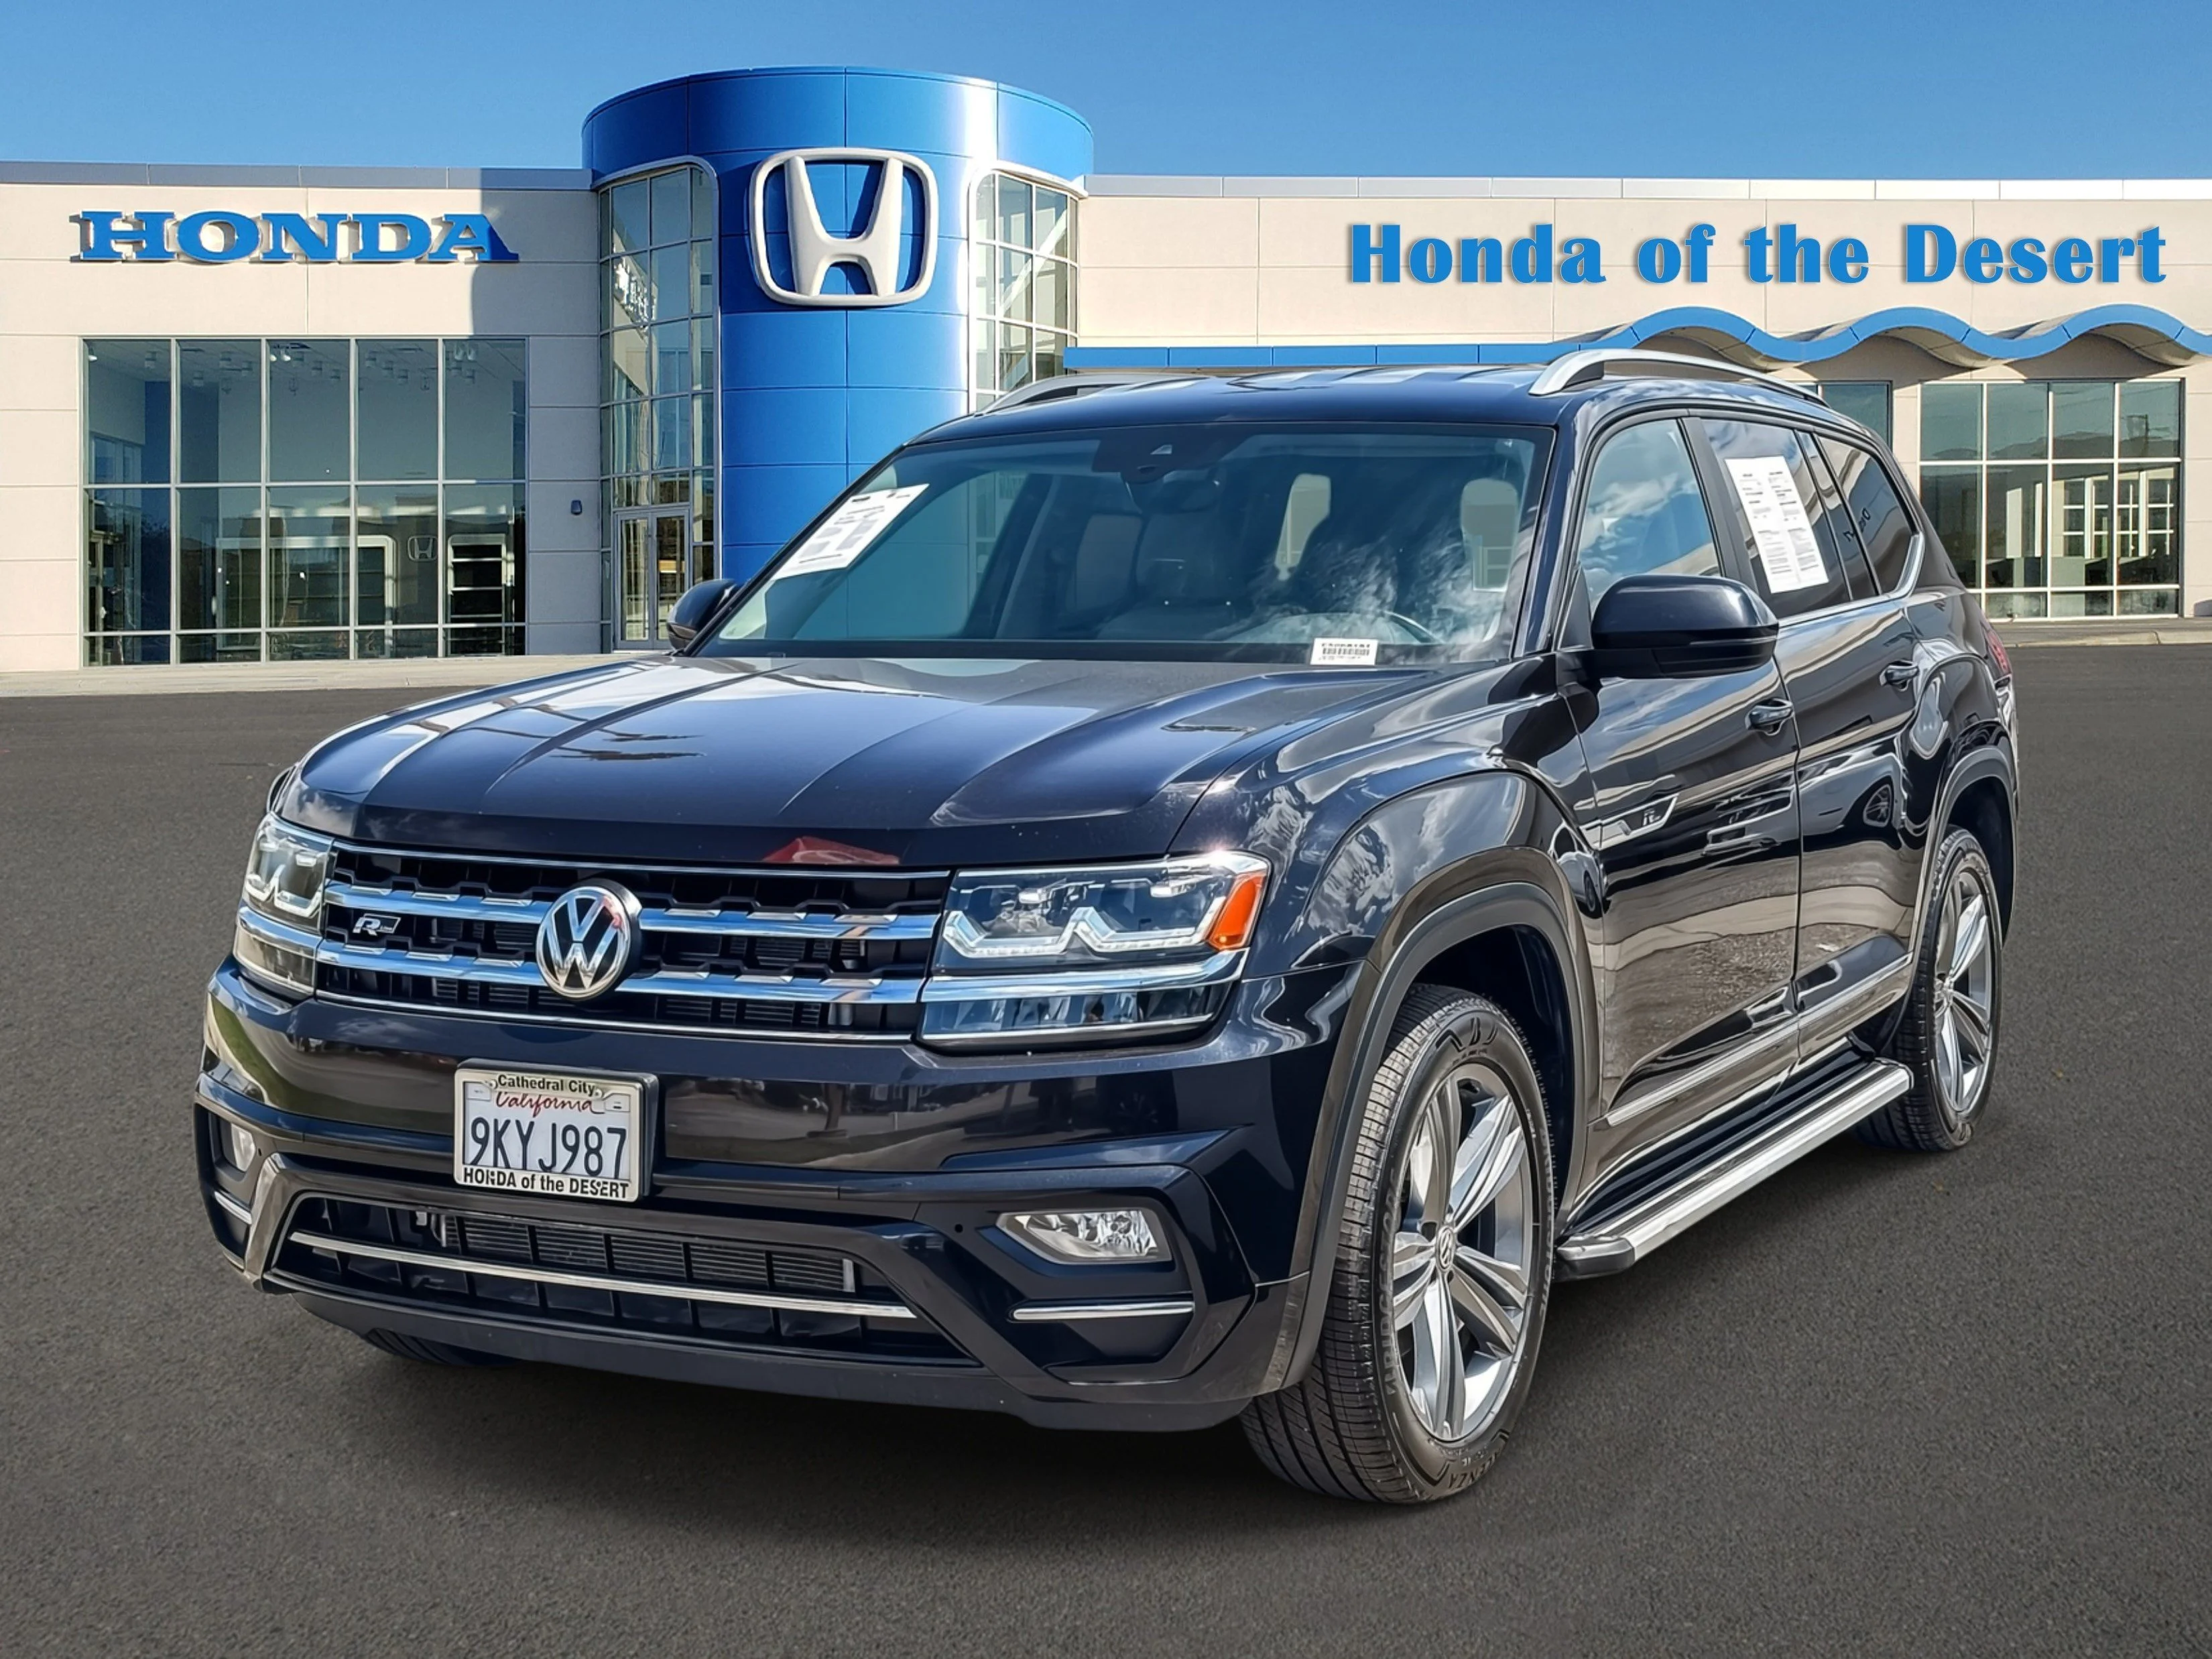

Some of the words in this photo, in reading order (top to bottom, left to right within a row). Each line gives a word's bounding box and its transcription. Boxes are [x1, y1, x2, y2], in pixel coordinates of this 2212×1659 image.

[81, 210, 519, 262] HONDA
[1351, 223, 1607, 284] Honda
[1638, 223, 1717, 284] of
[1743, 223, 1869, 284] the
[1906, 224, 2166, 284] Desert
[495, 1091, 605, 1118] California
[497, 1074, 564, 1091] Cathedral
[568, 1080, 595, 1097] City
[469, 1117, 627, 1179] 9KYJ987
[463, 1168, 517, 1187] HONDA
[521, 1172, 536, 1190] of
[540, 1174, 564, 1193] the
[570, 1177, 629, 1199] DESERT
